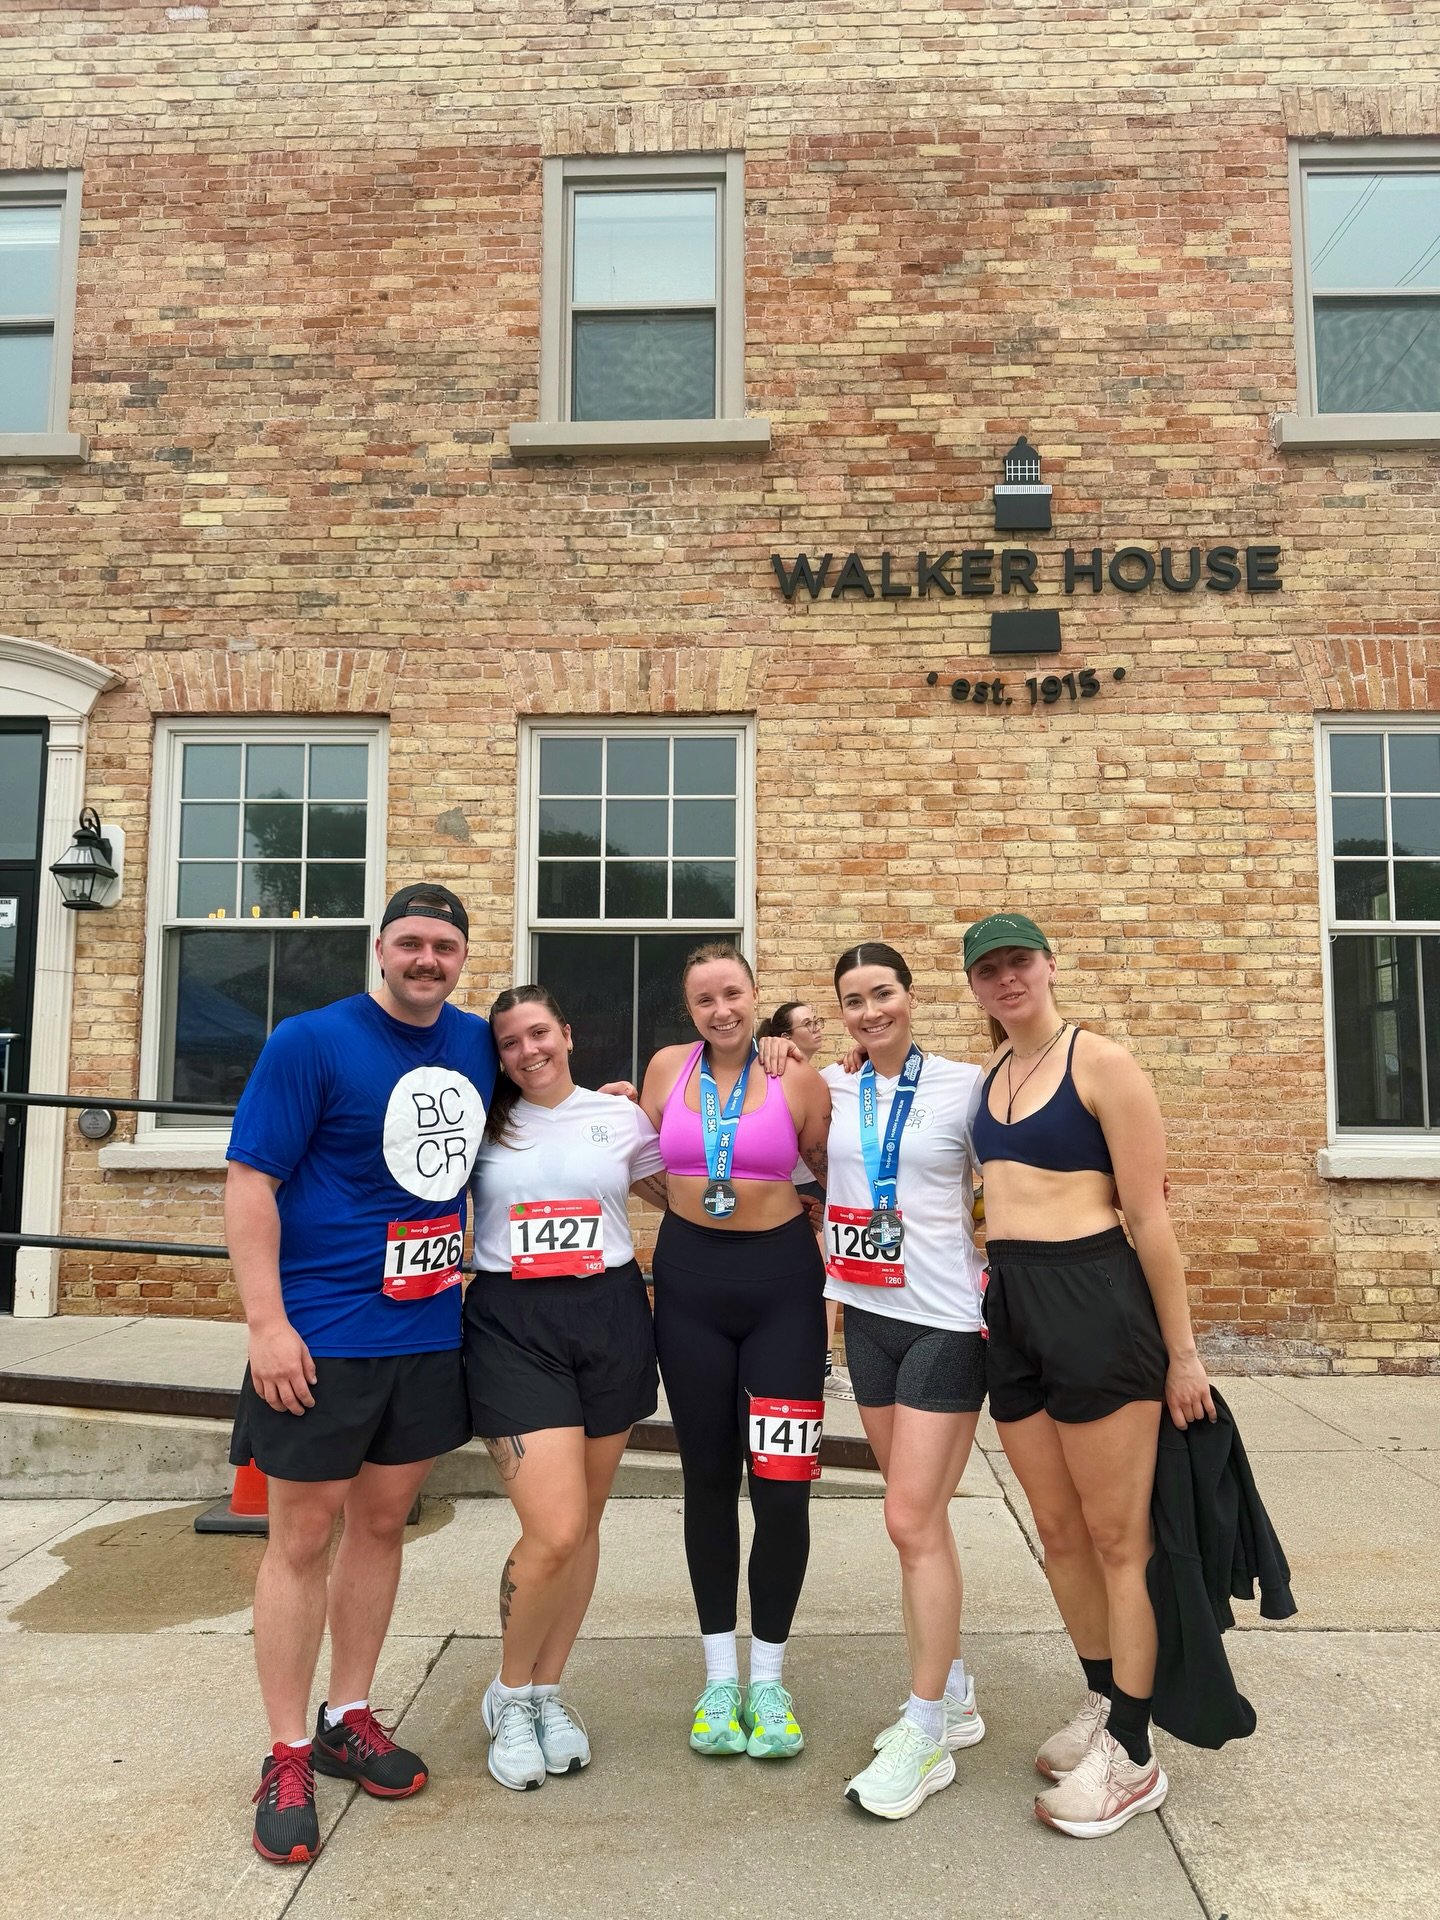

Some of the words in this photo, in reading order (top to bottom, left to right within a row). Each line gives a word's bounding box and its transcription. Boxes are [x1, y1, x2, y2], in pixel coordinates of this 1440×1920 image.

[772, 549, 1038, 599] WALKER
[1066, 545, 1283, 595] HOUSE
[951, 677, 1013, 706] est.
[1026, 668, 1101, 705] 1915
[412, 1087, 465, 1128] BC
[705, 1092, 716, 1116] 2026
[864, 1088, 873, 1112] 2026
[591, 1125, 608, 1133] BC
[707, 1119, 717, 1133] 5K
[865, 1113, 874, 1128] 5K
[592, 1134, 609, 1143] CR
[720, 1133, 732, 1148] 5K
[416, 1136, 467, 1178] CR
[716, 1150, 728, 1178] 2026
[880, 1194, 889, 1210] 5K
[518, 1218, 599, 1253] 1427
[394, 1233, 461, 1274] 1426
[586, 1262, 602, 1270] 1427
[885, 1276, 902, 1285] 1260
[756, 1417, 823, 1454] 1412
